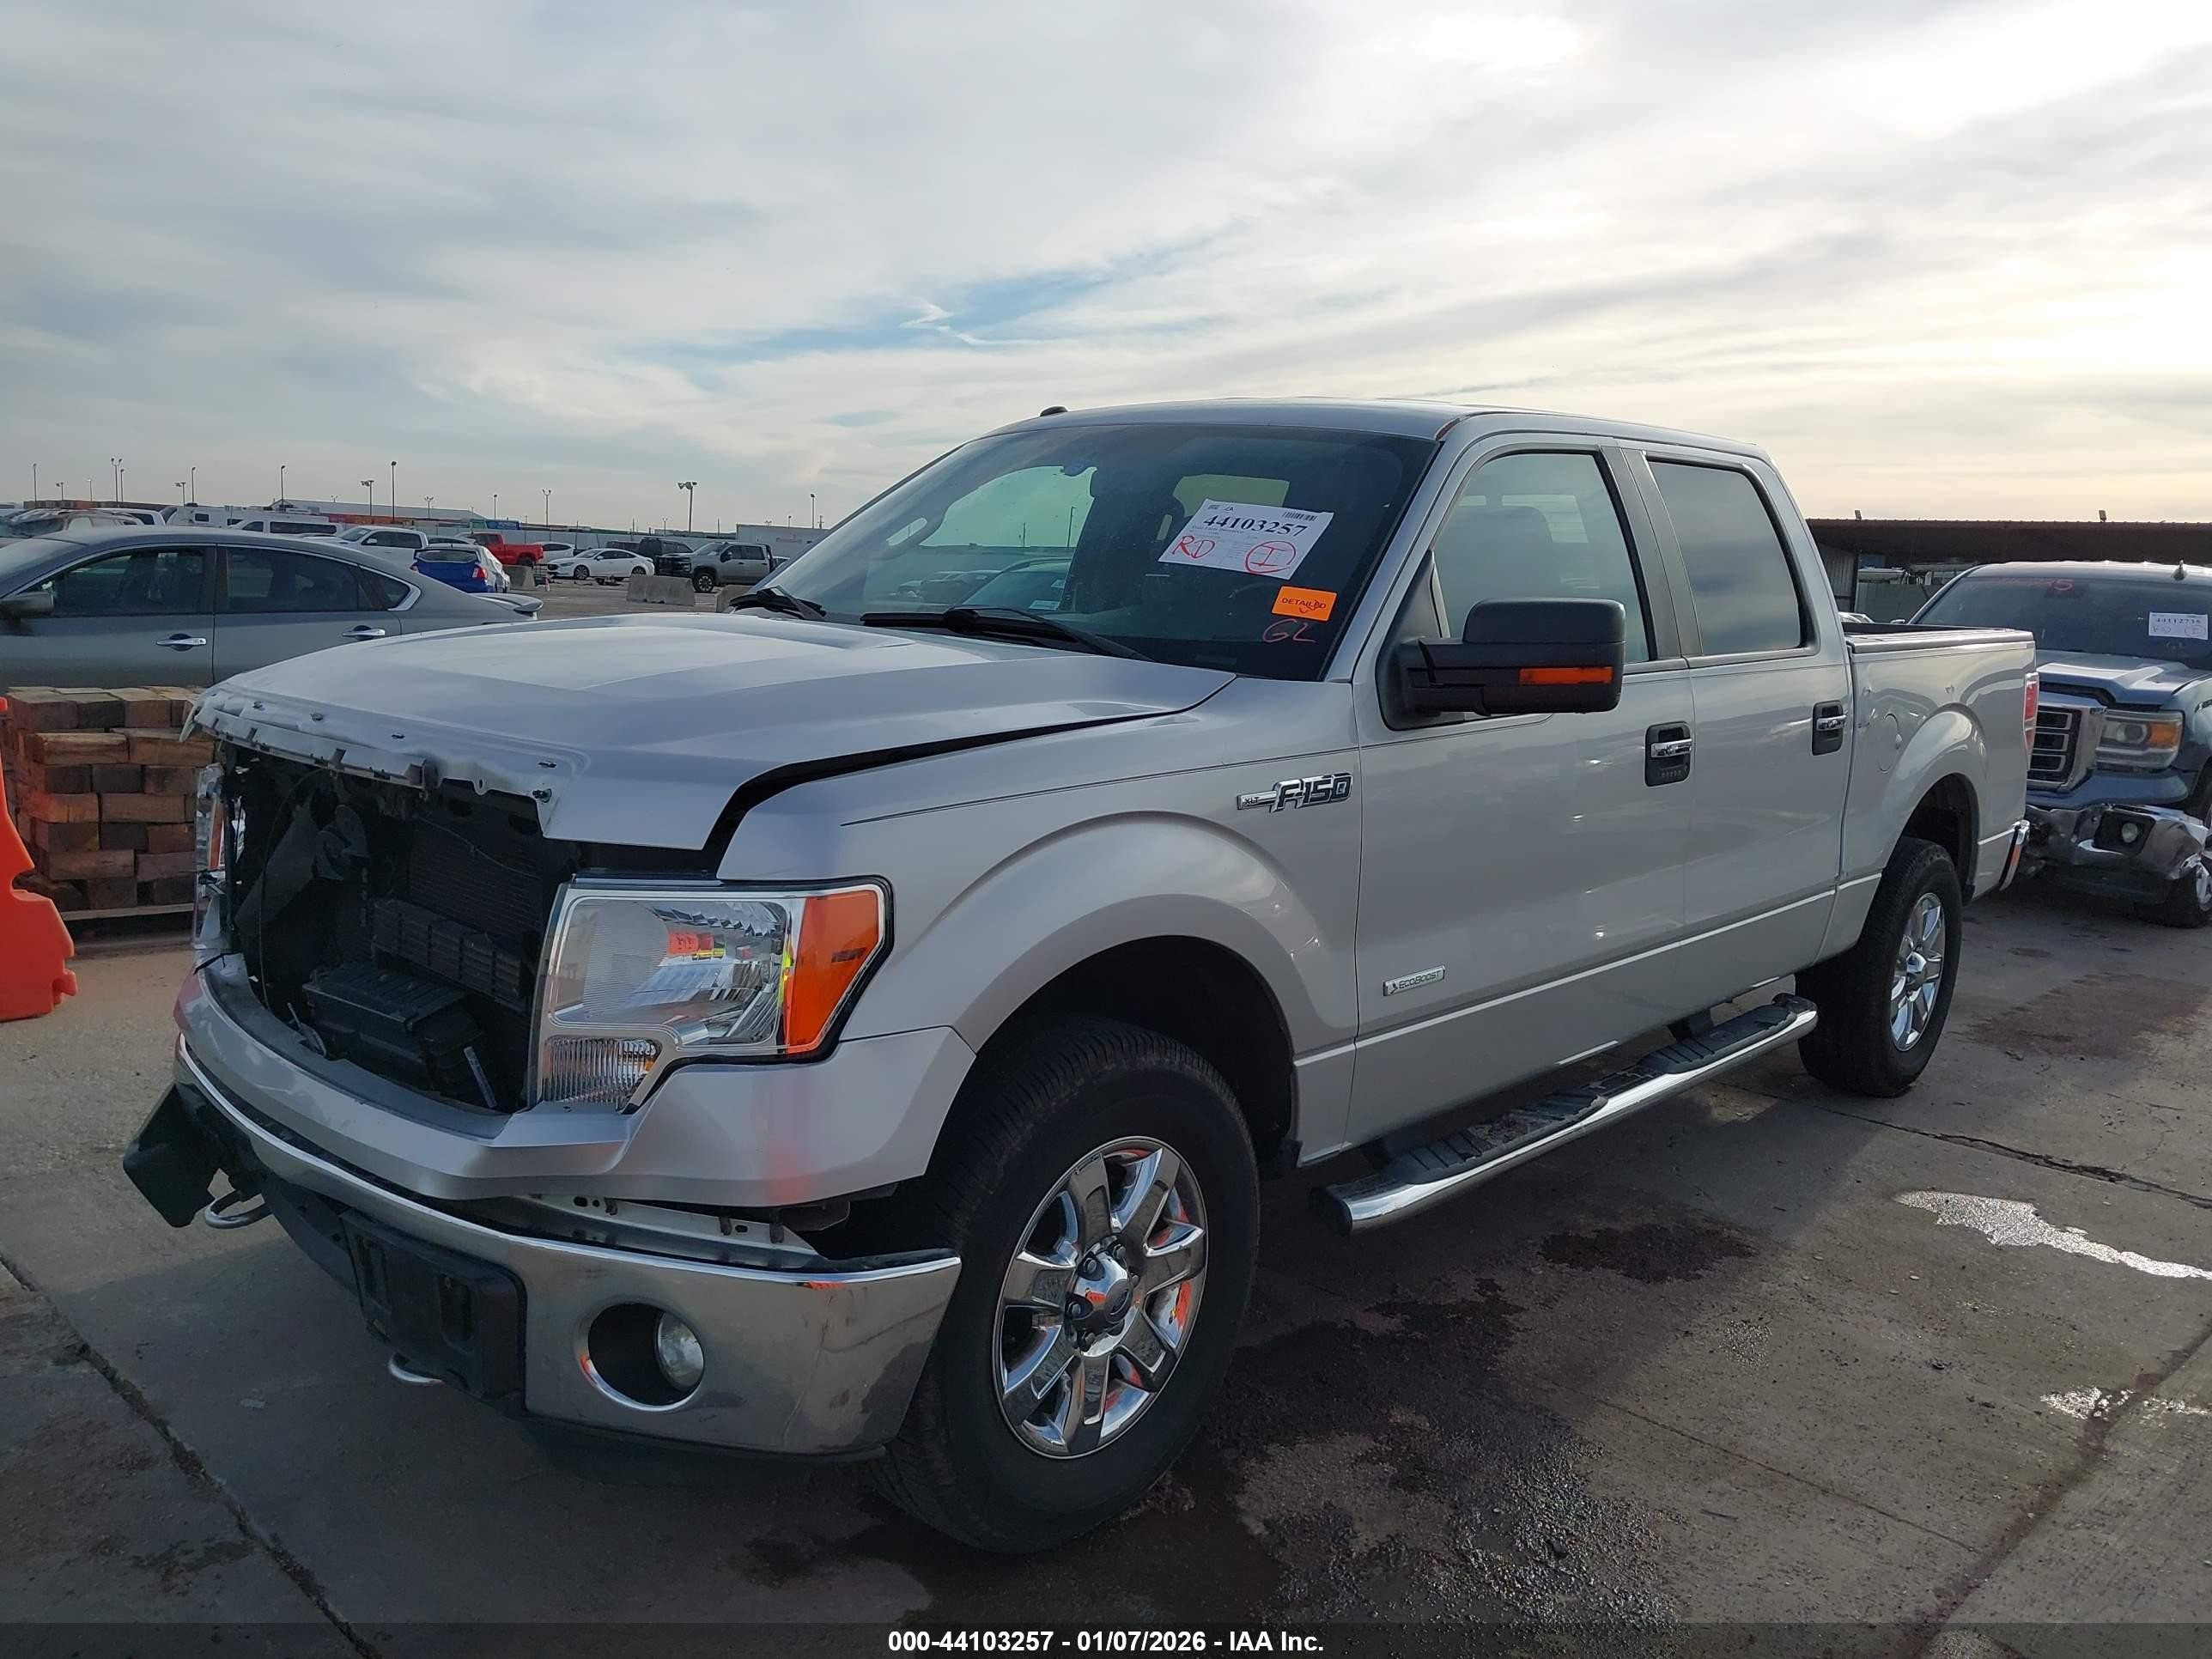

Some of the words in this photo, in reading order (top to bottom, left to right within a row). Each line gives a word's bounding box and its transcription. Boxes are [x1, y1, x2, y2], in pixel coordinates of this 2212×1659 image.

[1203, 515, 1309, 537] 44103257
[1171, 535, 1216, 559] RD
[1281, 598, 1327, 609] DETAILED
[1398, 969, 1442, 989] ECOBOOST
